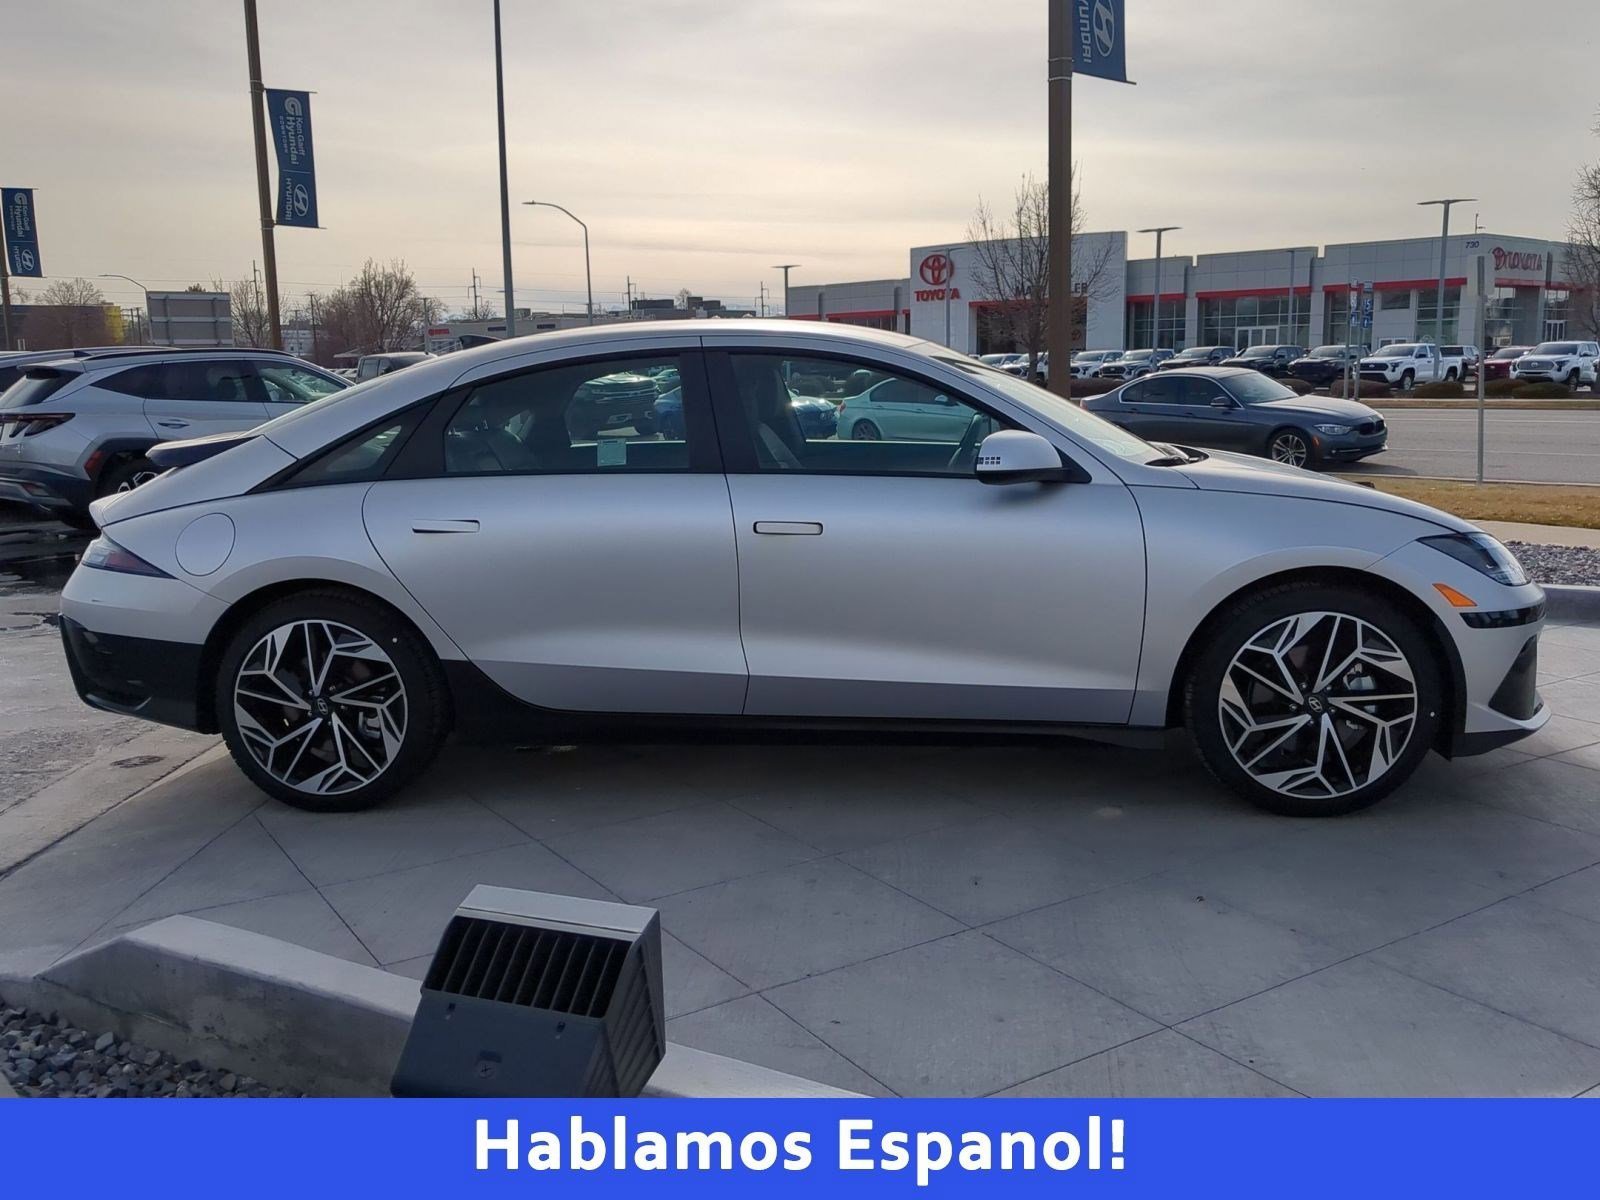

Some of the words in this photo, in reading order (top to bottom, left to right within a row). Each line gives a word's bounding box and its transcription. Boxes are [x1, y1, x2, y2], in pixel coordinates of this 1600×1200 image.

[285, 116, 299, 165] Hyundai
[298, 135, 306, 156] Garff
[285, 178, 293, 220] HYUNDAI
[14, 205, 24, 237] Hyundai
